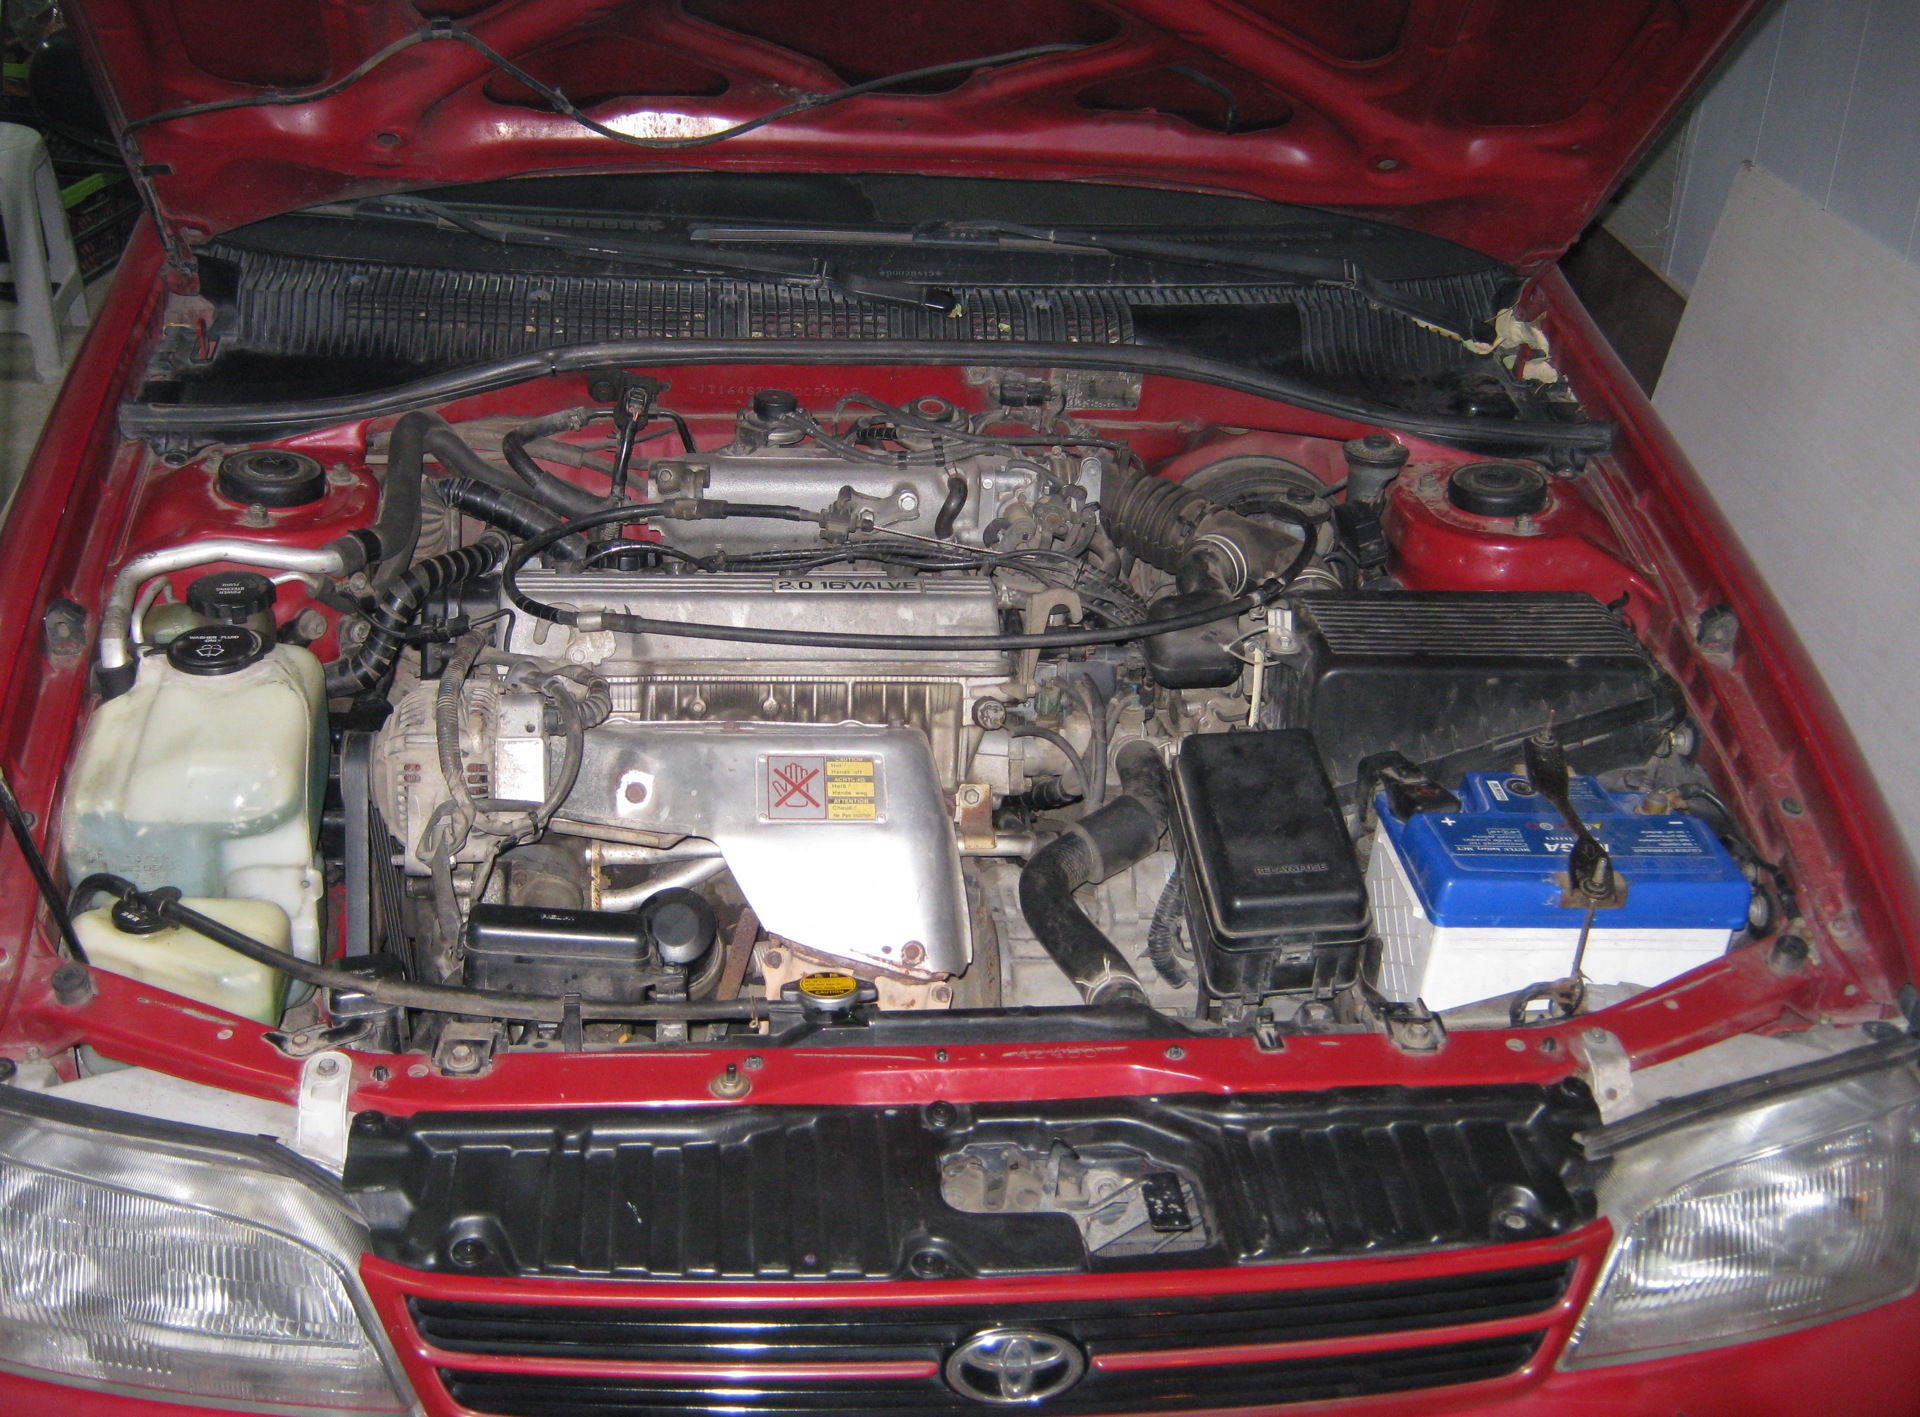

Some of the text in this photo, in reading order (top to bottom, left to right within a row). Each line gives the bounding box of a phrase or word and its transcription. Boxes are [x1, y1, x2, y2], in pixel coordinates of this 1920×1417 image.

[778, 581, 813, 590] 2.0
[1544, 843, 1610, 852] MGA
[1255, 863, 1328, 875] RELAY&FUSE
